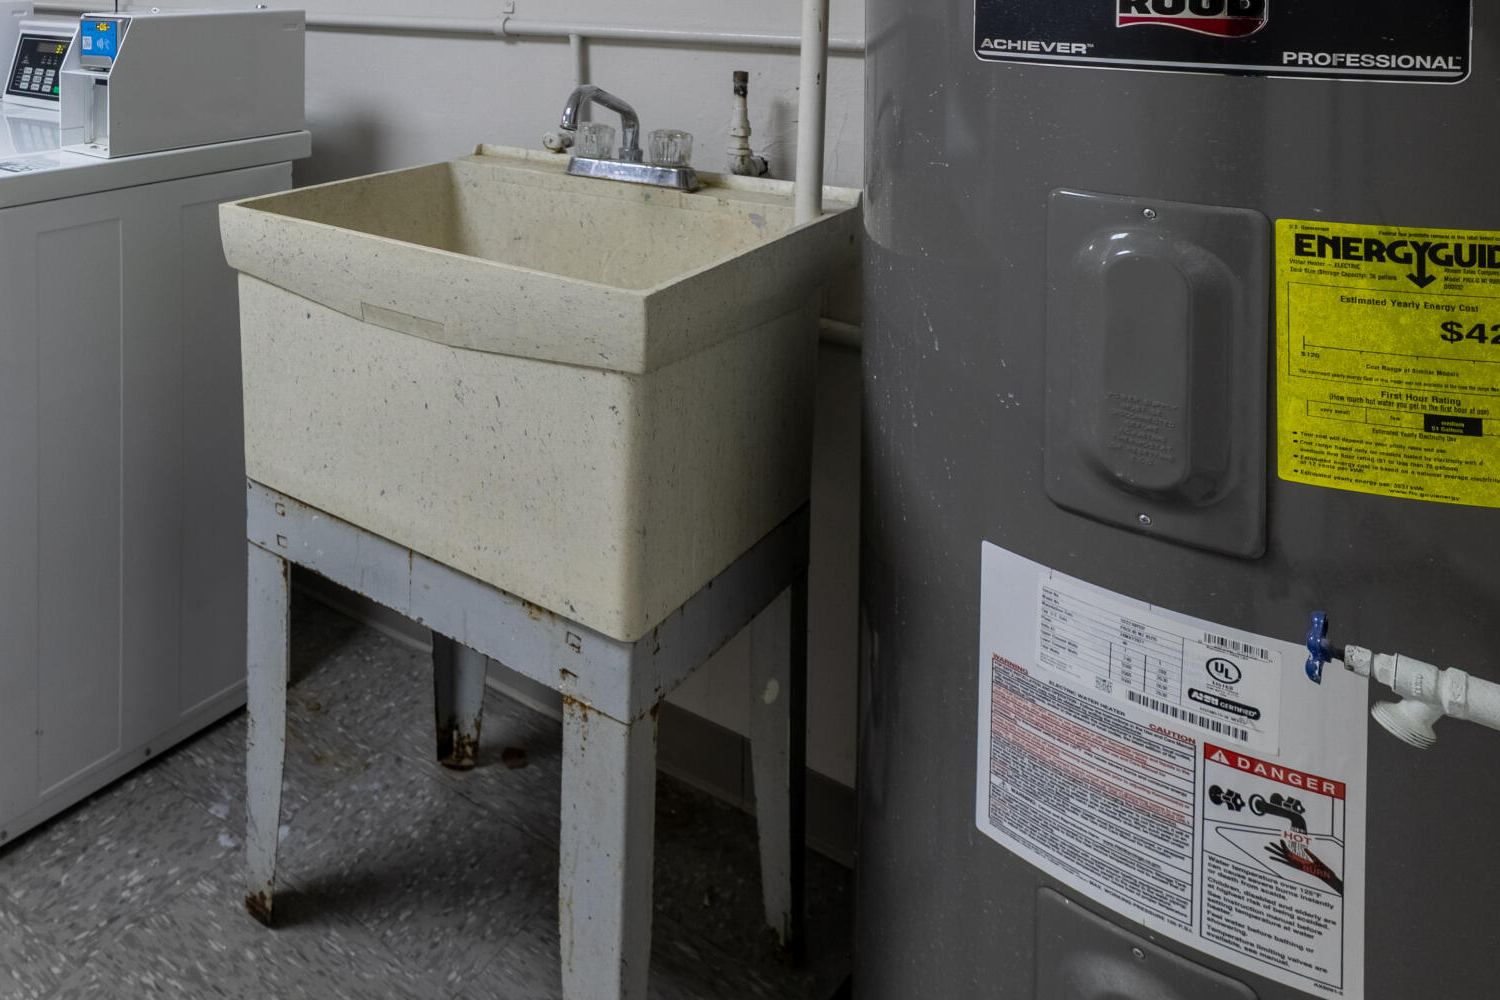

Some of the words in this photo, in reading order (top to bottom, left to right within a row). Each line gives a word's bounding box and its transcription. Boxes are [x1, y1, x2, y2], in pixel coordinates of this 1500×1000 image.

[1340, 294, 1386, 306] Estimated
[1390, 298, 1420, 310] Yearly
[1423, 301, 1455, 312] Energy
[1459, 303, 1478, 313] Cost
[1380, 389, 1401, 400] First
[1405, 393, 1429, 403] Hour
[1431, 395, 1461, 406] Rating
[992, 652, 1029, 675] WARNING
[1214, 661, 1233, 681] UL
[1078, 692, 1098, 706] WATER
[1099, 702, 1125, 717] HEATER
[1148, 723, 1197, 745] CAUTION
[1236, 755, 1335, 796] DANGER
[1283, 829, 1312, 847] HOT
[1207, 855, 1229, 867] Water
[1231, 863, 1278, 885] temperature
[1279, 880, 1296, 890] over
[1300, 886, 1321, 899] 125°F
[1207, 861, 1221, 870] can
[1223, 867, 1246, 879] cause
[1247, 876, 1273, 888] severe
[1275, 885, 1298, 897] burns
[1300, 893, 1334, 910] instantly
[1217, 871, 1238, 883] death
[1240, 879, 1258, 890] from
[1260, 886, 1287, 901] scalds.
[1207, 876, 1241, 893] Children,
[1243, 889, 1276, 905] disabled
[1278, 901, 1292, 911] and
[1294, 907, 1321, 922] elderly
[1323, 917, 1336, 925] are
[1207, 902, 1230, 915] heater.
[1207, 889, 1221, 899] See
[1223, 896, 1264, 915] instruction
[1266, 911, 1294, 926] manual
[1297, 922, 1322, 935] before
[1216, 885, 1244, 900] highest
[1246, 896, 1260, 906] risk
[1272, 905, 1294, 919] being
[1296, 913, 1328, 930] scalded.
[1206, 916, 1247, 937] showering.
[1207, 896, 1232, 911] setting
[1234, 907, 1281, 929] temperature
[1292, 927, 1313, 939] water
[1207, 909, 1222, 920] Feel
[1224, 916, 1244, 928] water
[1247, 924, 1271, 938] before
[1274, 934, 1303, 952] bathing
[1206, 931, 1241, 949] available,
[1244, 946, 1257, 955] see
[1259, 951, 1289, 967] manual.
[1207, 924, 1254, 947] Temperature
[1256, 943, 1285, 959] limiting
[1287, 954, 1312, 969] valves
[1314, 965, 1327, 974] are
